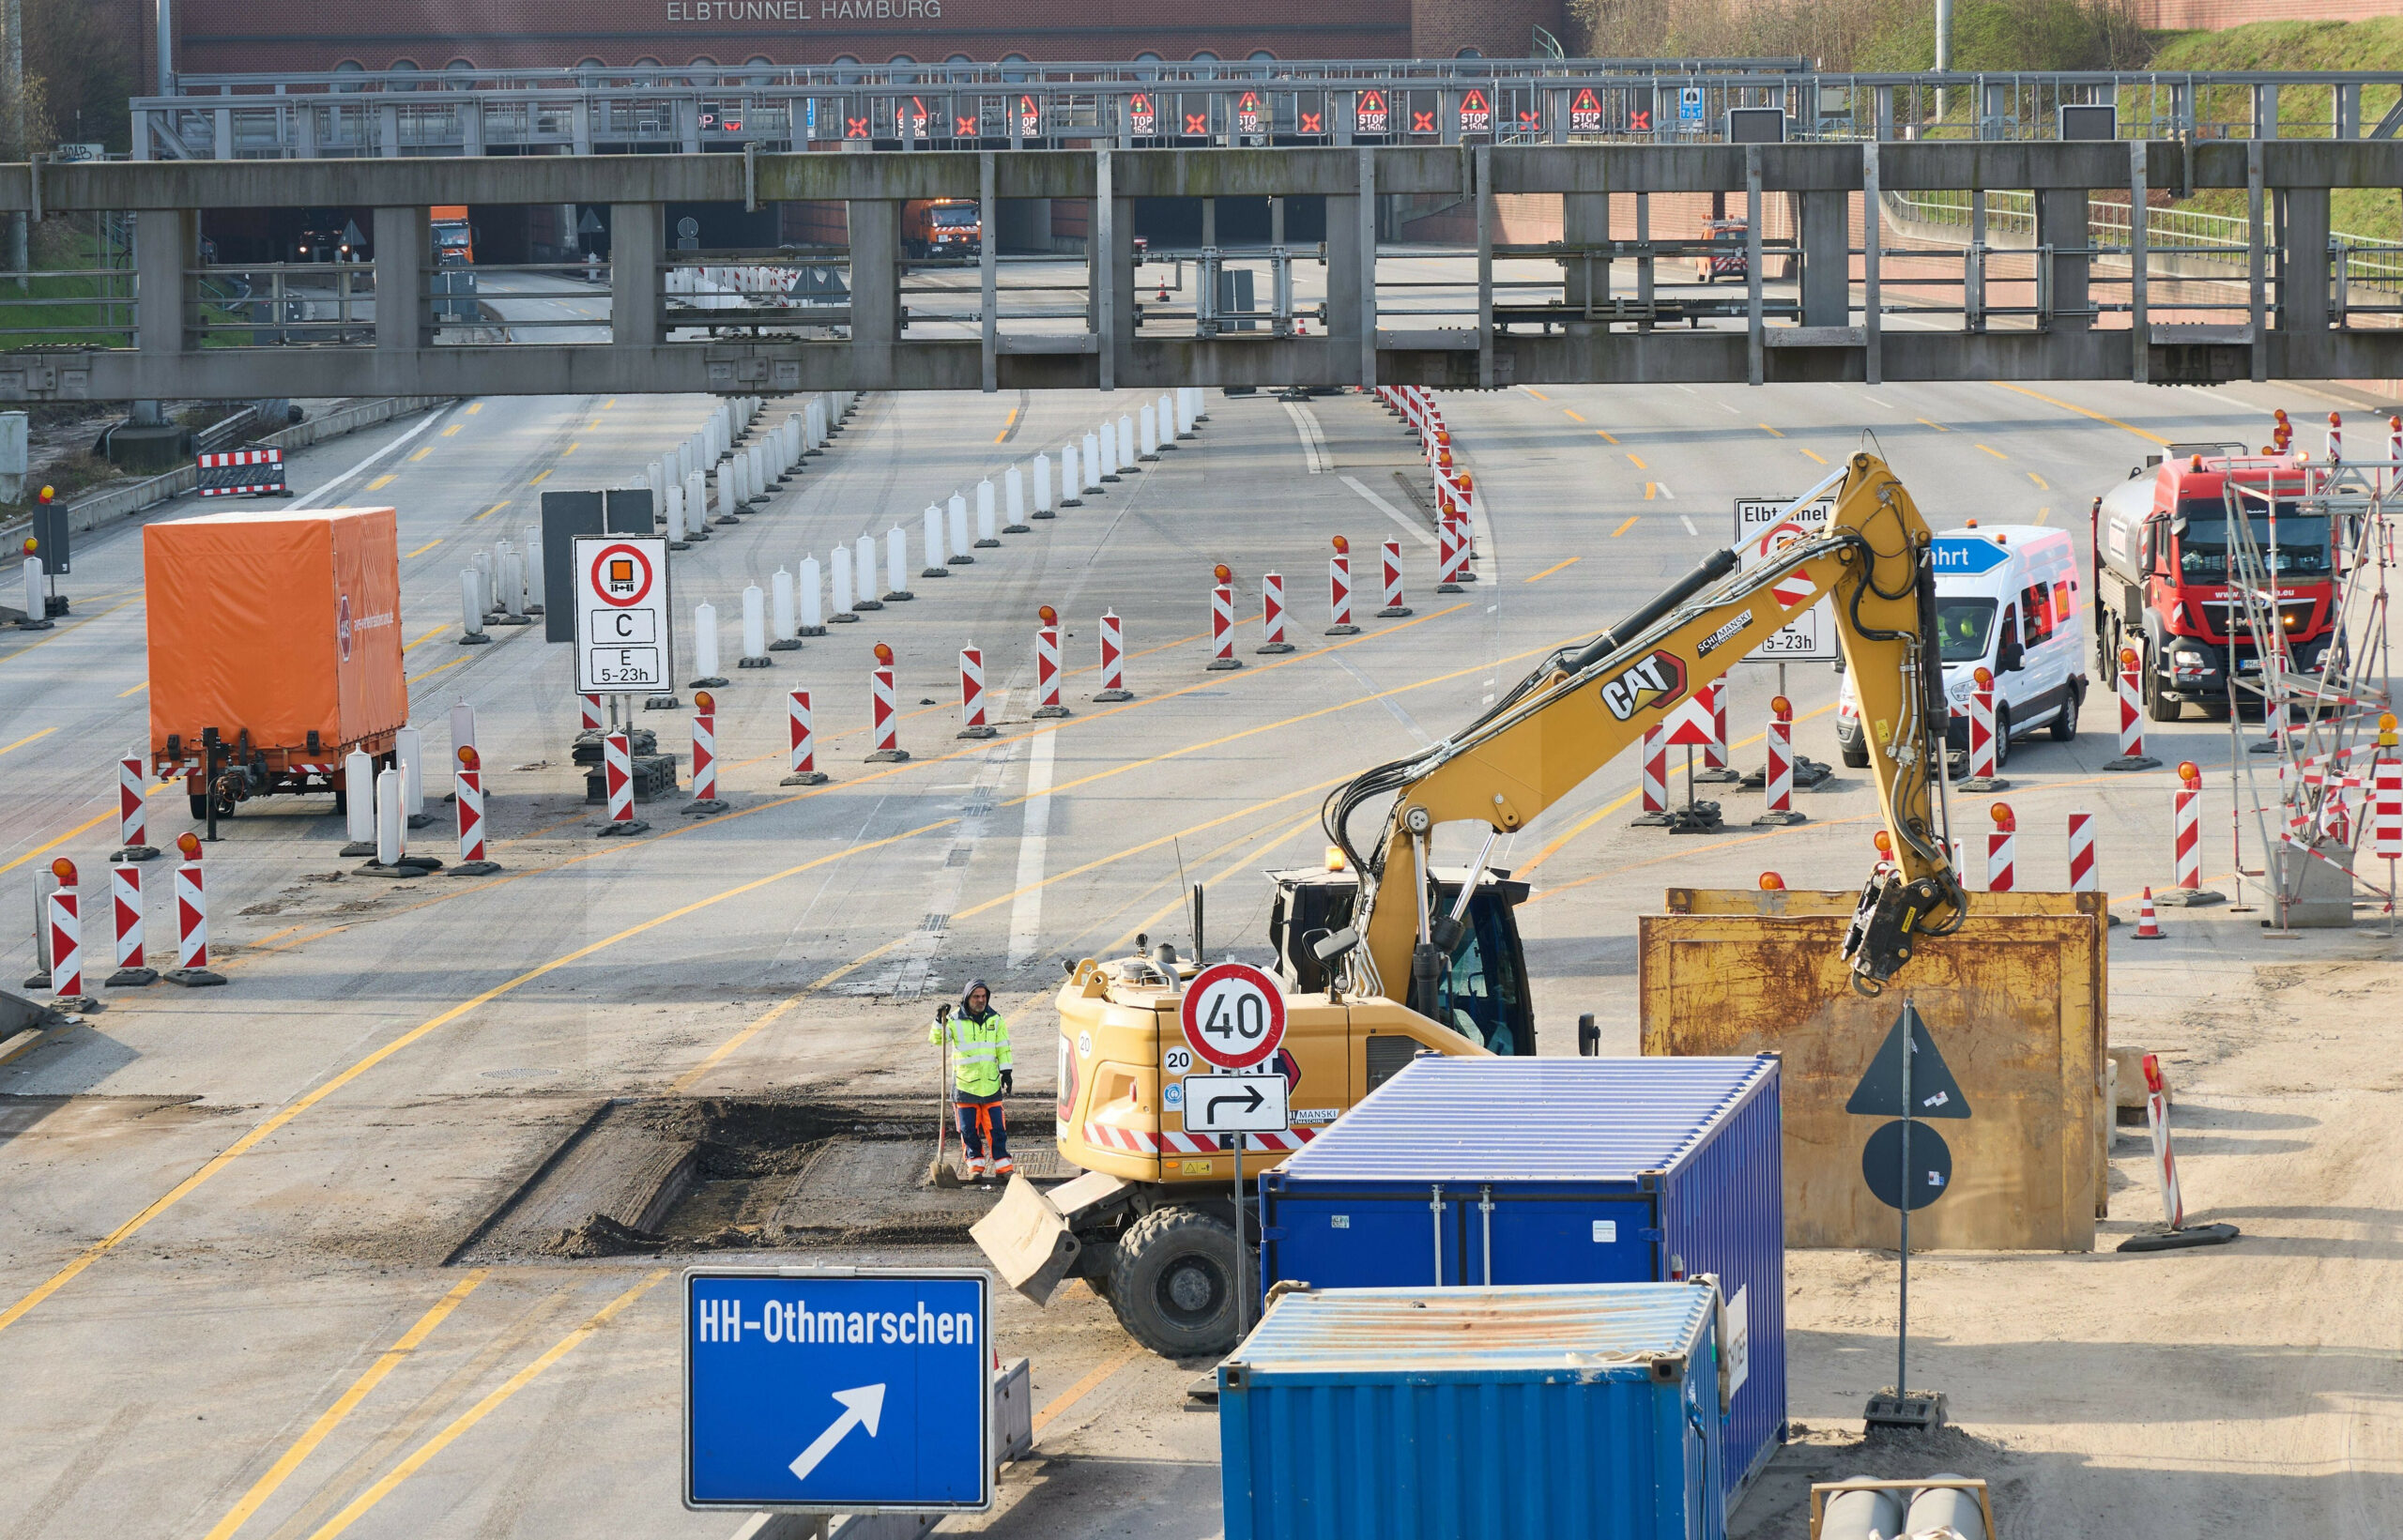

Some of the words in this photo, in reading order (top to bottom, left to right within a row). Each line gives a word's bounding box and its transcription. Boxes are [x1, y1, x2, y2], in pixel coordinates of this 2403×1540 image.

[667, 1, 811, 21] ELBTUNNEL
[821, 0, 941, 19] HAMBURG
[1131, 116, 1154, 125] TOP
[1239, 115, 1256, 125] STO
[1359, 114, 1386, 124] STOP
[1462, 113, 1488, 123] STOP
[1573, 113, 1599, 123] STOP
[616, 613, 633, 637] C
[1767, 635, 1813, 649] 5-23h
[620, 649, 632, 666] E
[602, 668, 649, 681] 5-23h
[1601, 654, 1669, 721] CAT
[1205, 993, 1263, 1039] 40
[1079, 1036, 1091, 1052] 20
[1168, 1052, 1190, 1068] 20
[700, 1299, 973, 1345] HH-Othmarschen
